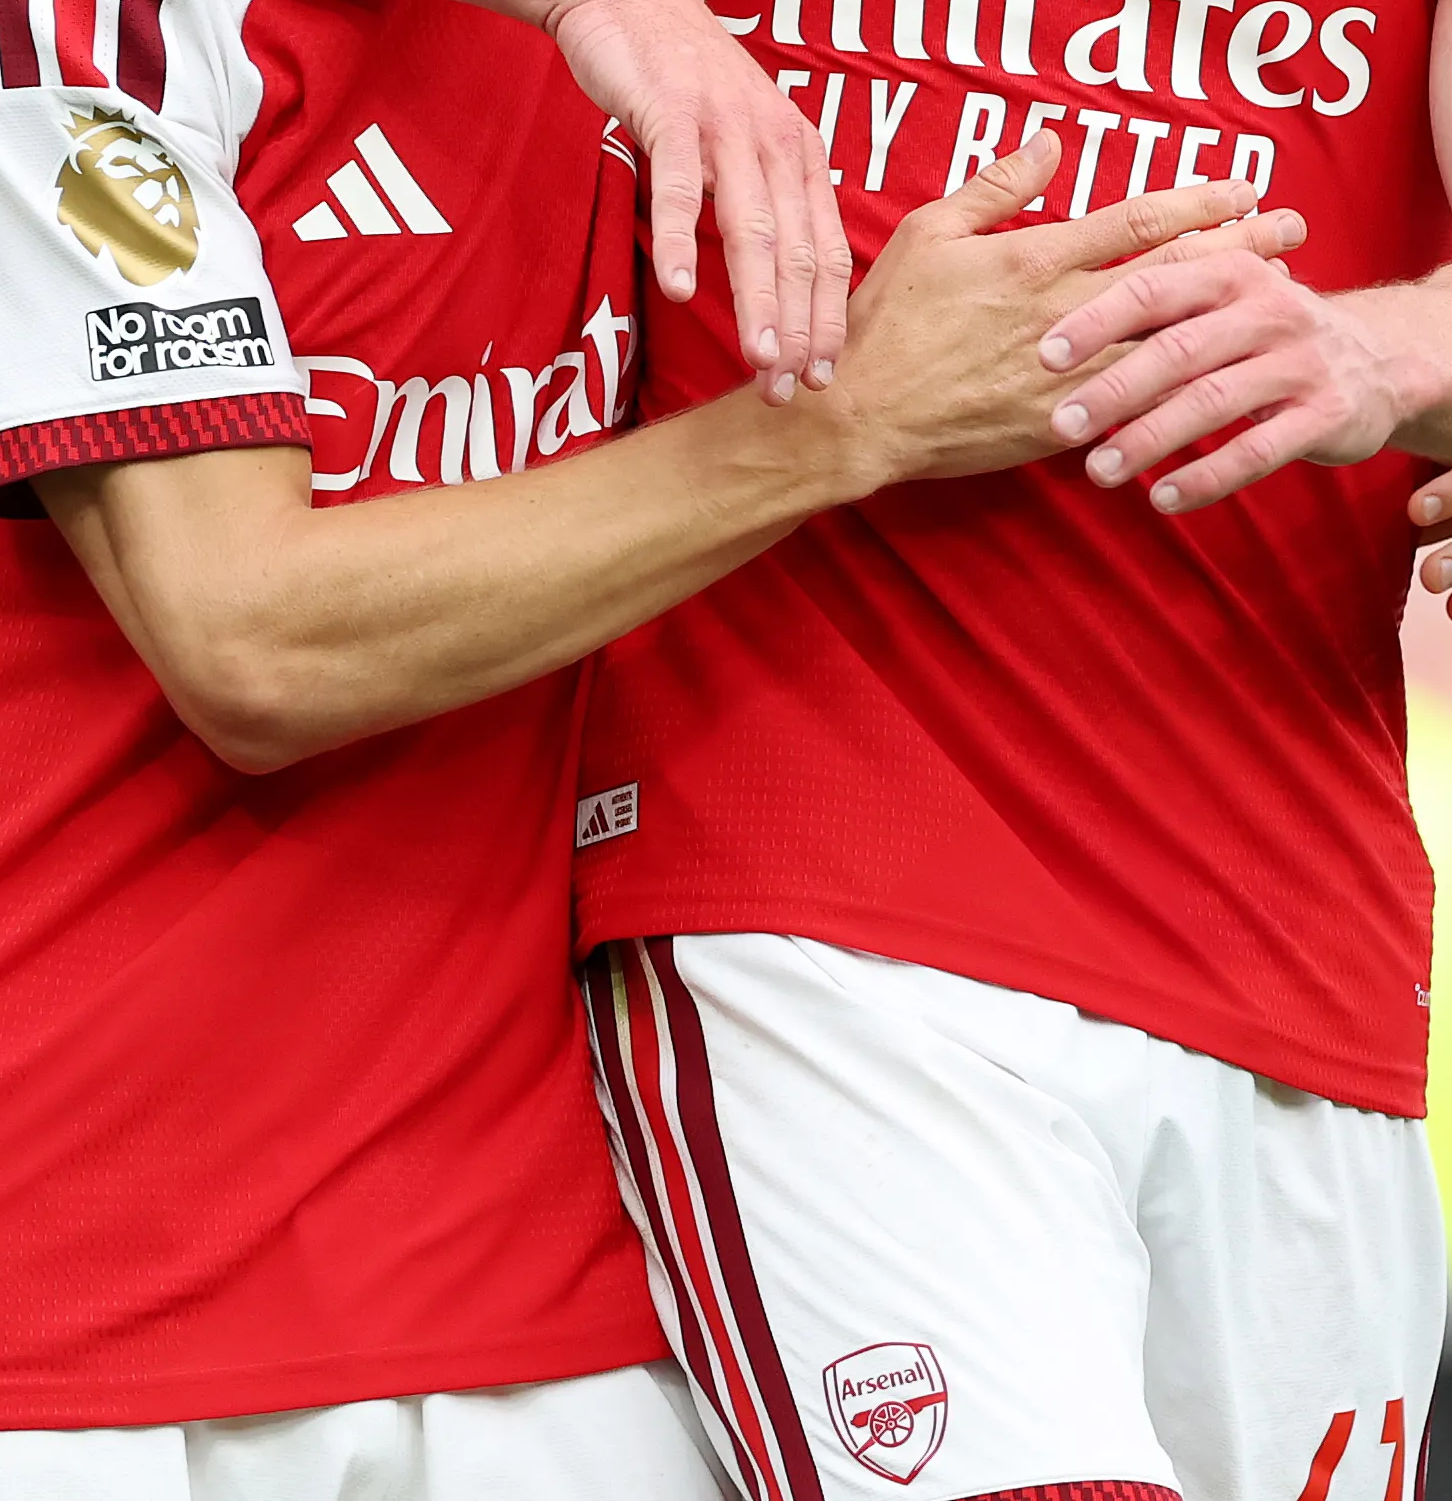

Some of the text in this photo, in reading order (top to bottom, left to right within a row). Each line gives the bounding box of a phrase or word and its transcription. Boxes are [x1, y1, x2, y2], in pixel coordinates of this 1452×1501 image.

[86, 307, 252, 349] No room
[292, 293, 636, 491] Emirat
[842, 1361, 925, 1401] Arsenal
